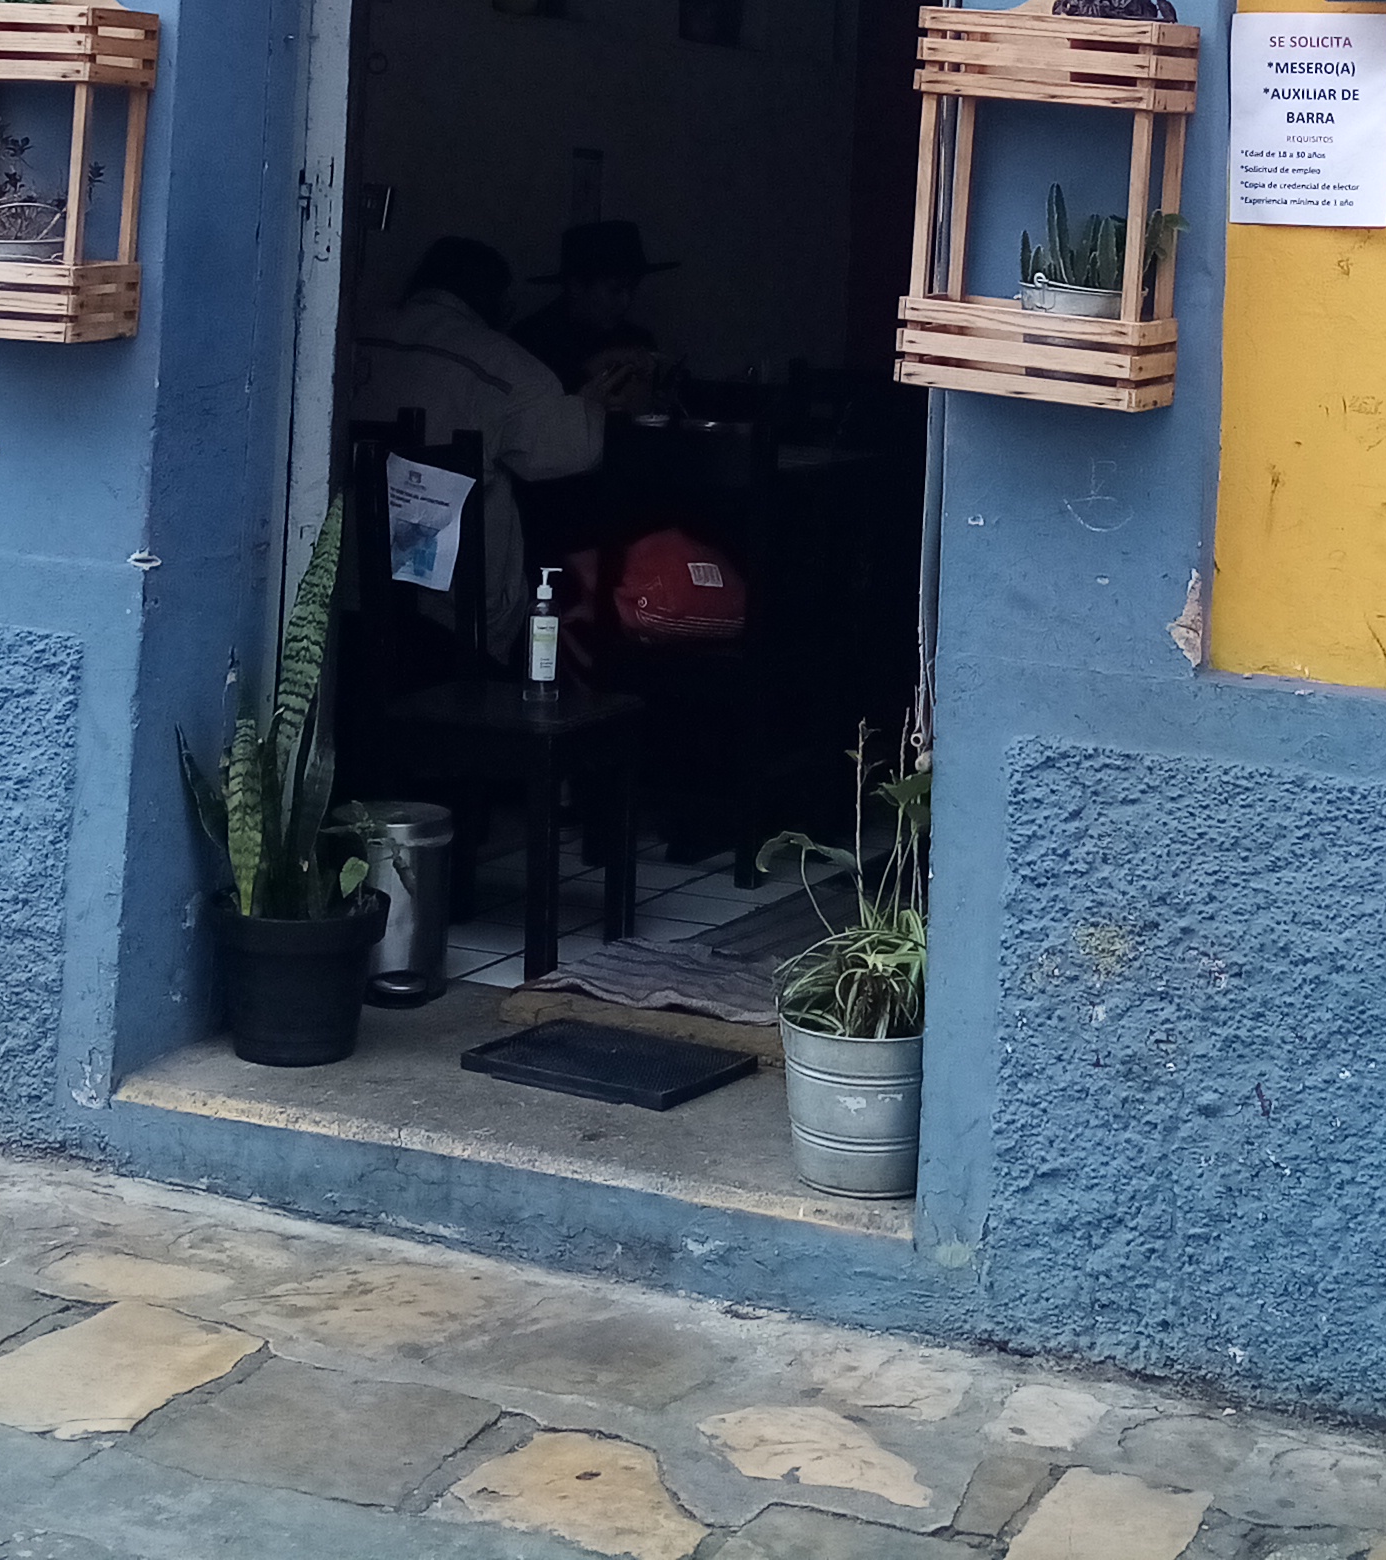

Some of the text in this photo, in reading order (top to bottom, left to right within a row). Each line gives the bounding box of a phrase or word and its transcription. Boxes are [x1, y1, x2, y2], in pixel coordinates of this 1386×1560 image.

[1269, 36, 1353, 48] SE SOLICITA
[1341, 88, 1360, 101] DE
[1286, 111, 1335, 124] BARRA
[1286, 135, 1334, 144] REQUISITOS
[1266, 150, 1276, 158] de
[1280, 166, 1290, 174] de
[1292, 166, 1321, 175] empleo
[1268, 181, 1277, 189] de
[1279, 182, 1319, 190] credencial
[1321, 182, 1331, 190] de
[1333, 182, 1360, 191] elector
